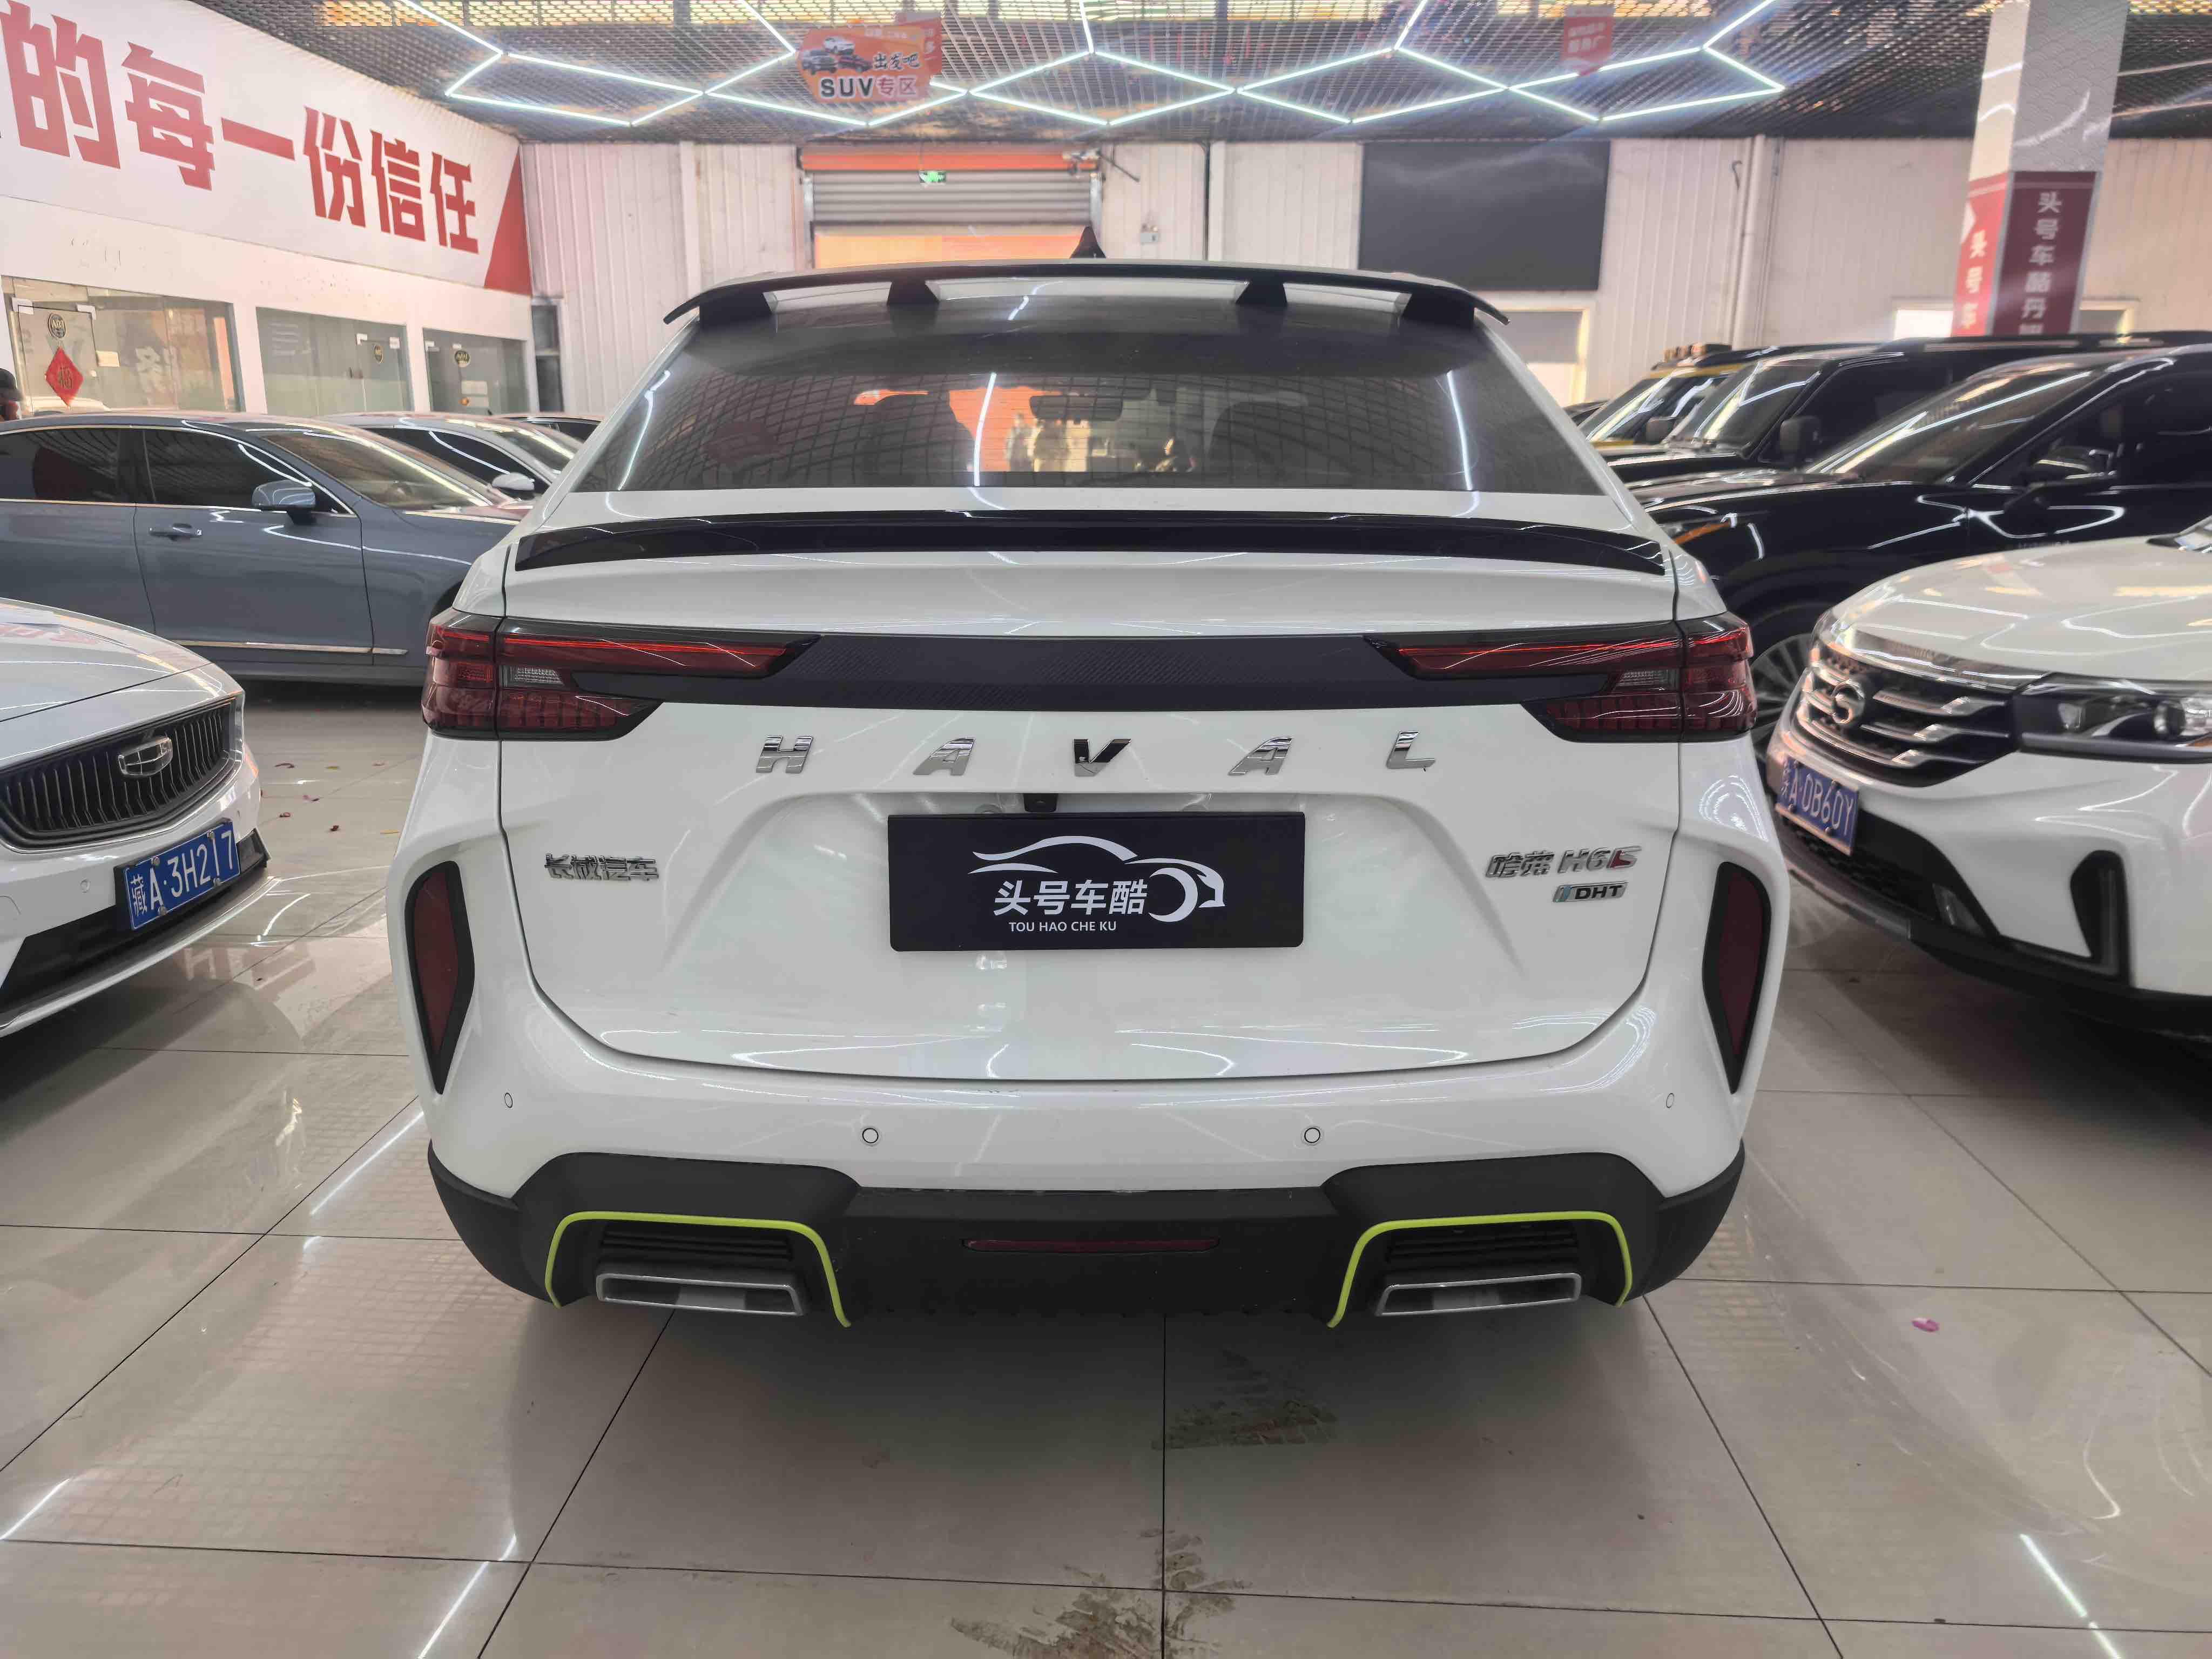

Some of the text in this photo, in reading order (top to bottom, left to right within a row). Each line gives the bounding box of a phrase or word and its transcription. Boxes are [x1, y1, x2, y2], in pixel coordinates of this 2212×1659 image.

[0, 0, 480, 254] 的每一份信任
[756, 730, 1436, 777] HAVAL
[993, 878, 1149, 916] 头号车酷
[1575, 885, 1623, 900] DHT
[1009, 921, 1117, 932] TOU HAO CHE KU
